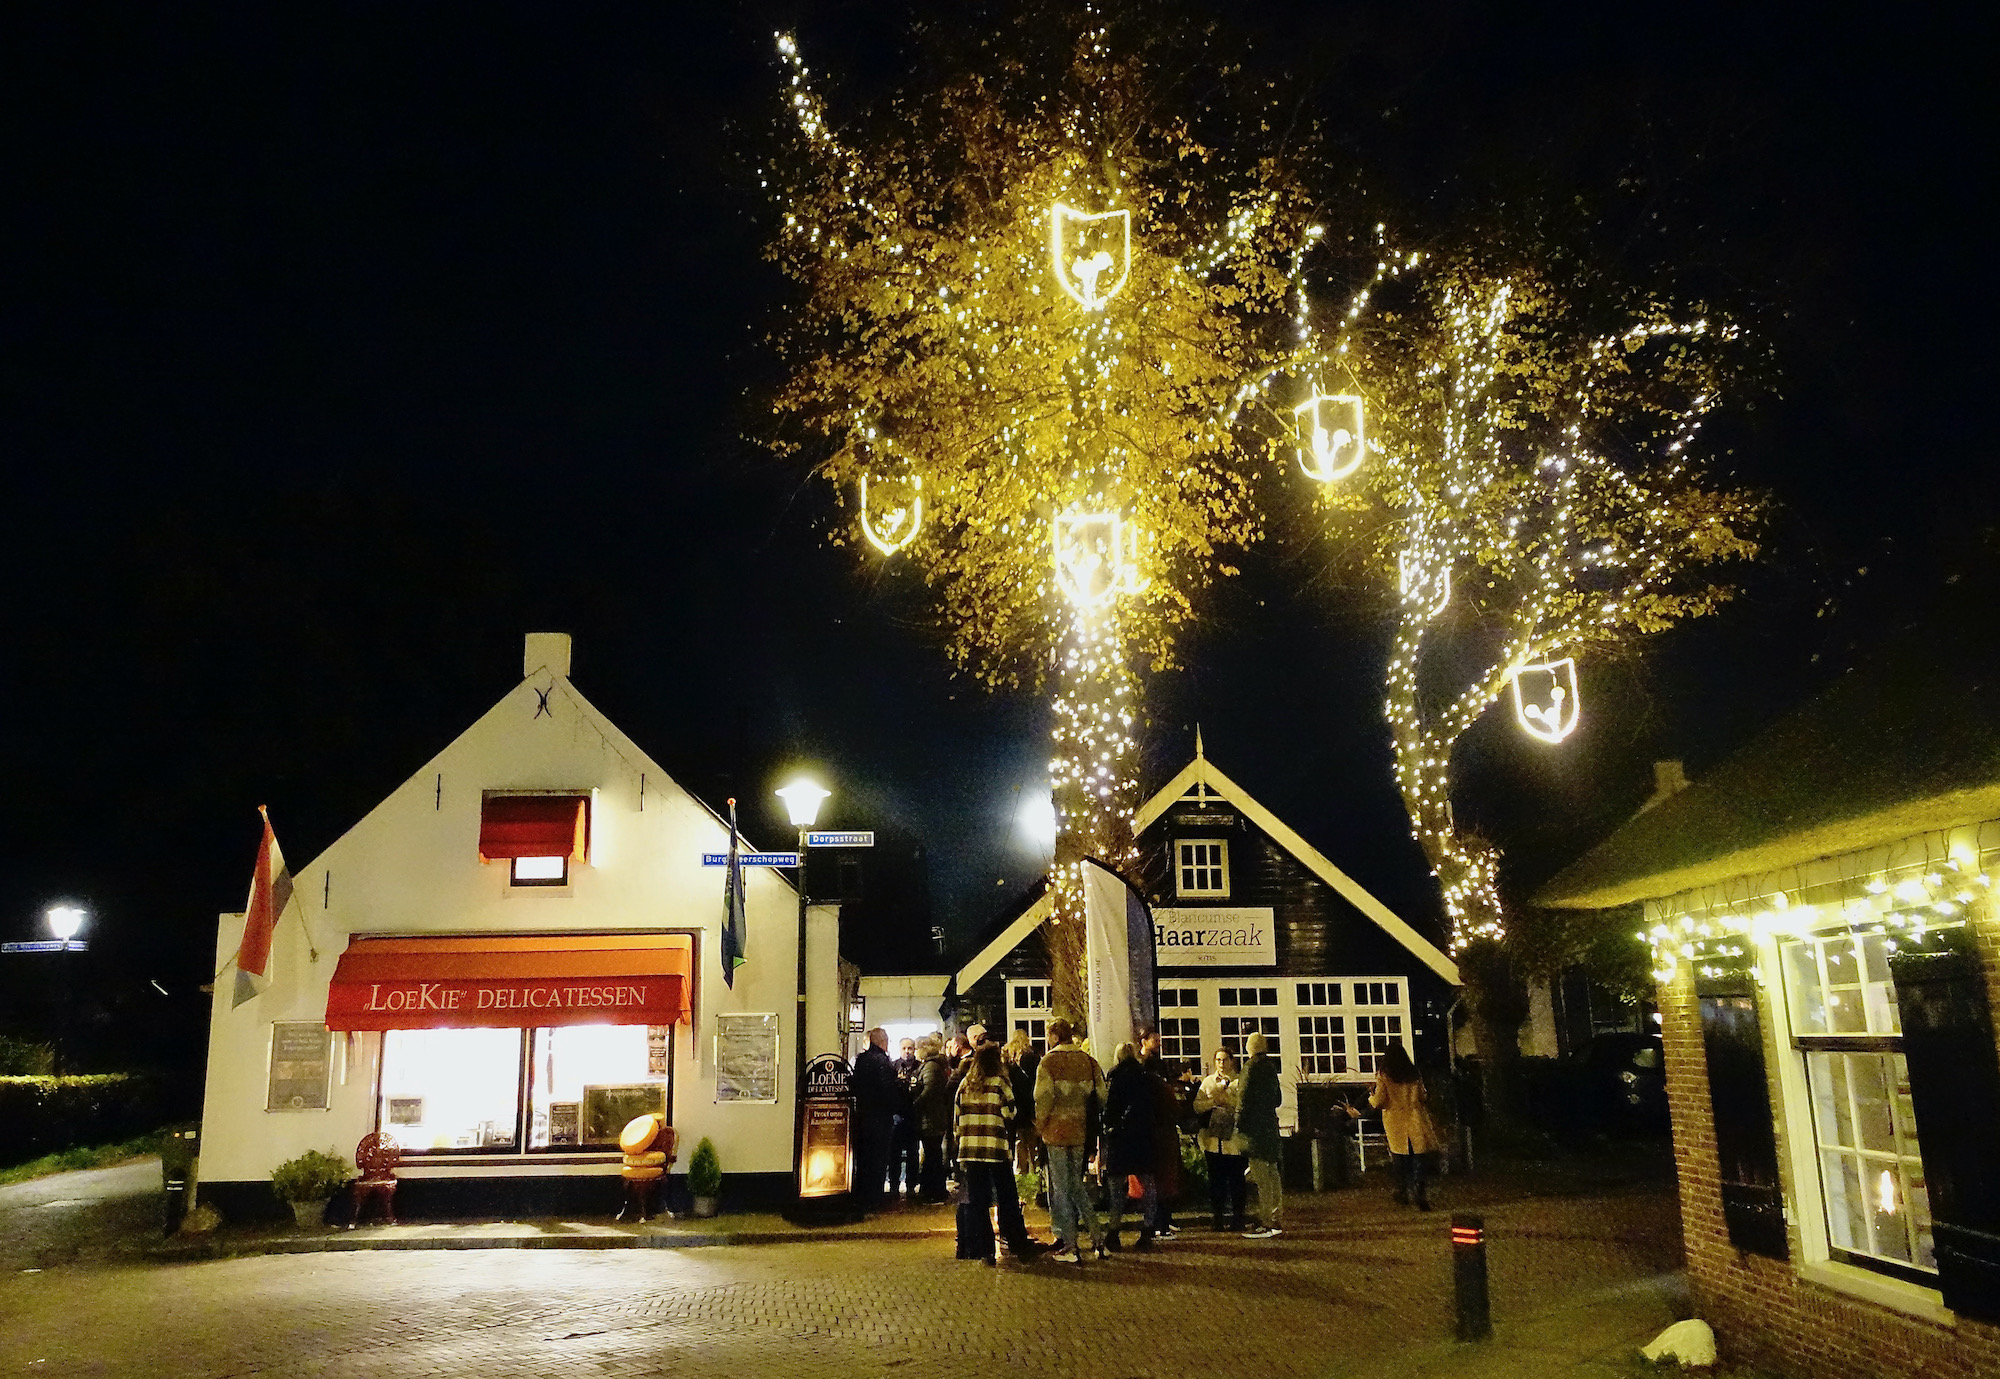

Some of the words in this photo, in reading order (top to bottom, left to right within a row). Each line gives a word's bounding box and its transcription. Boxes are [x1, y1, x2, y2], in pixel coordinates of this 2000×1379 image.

[813, 835, 868, 843] Dorpsstraat
[1155, 923, 1263, 946] Haarzaak
[477, 986, 647, 1008] DELICATESSEN
